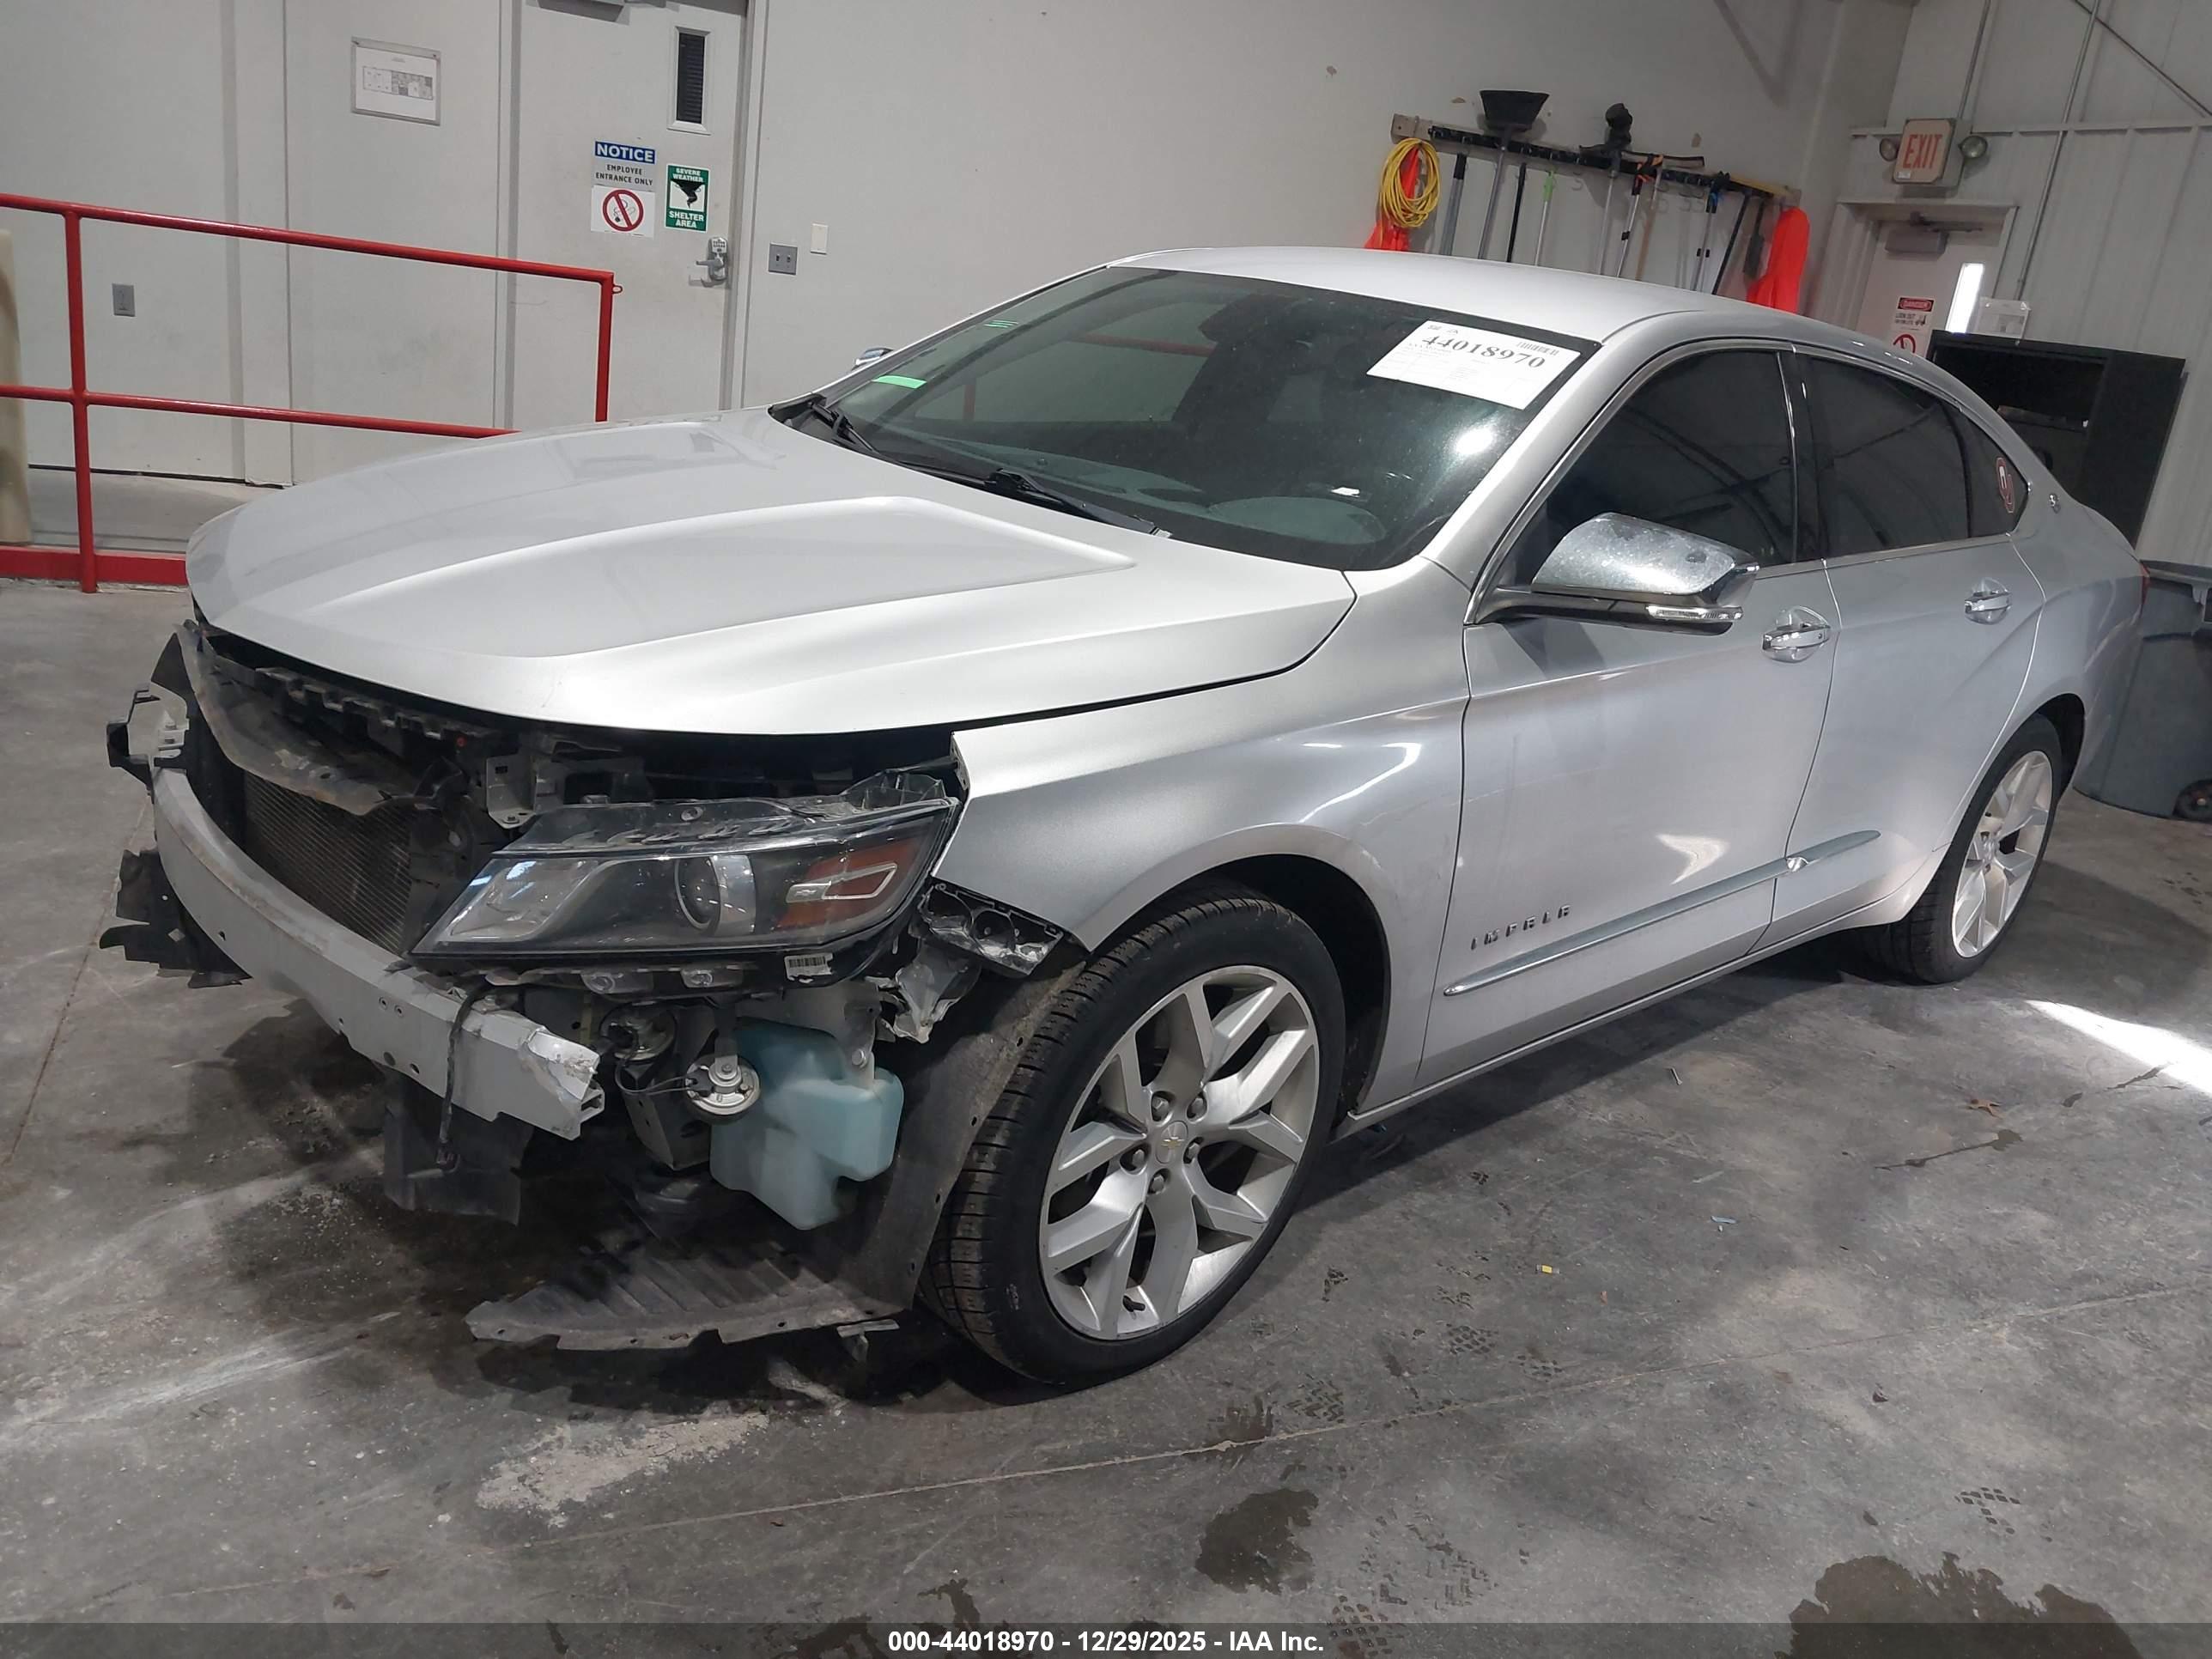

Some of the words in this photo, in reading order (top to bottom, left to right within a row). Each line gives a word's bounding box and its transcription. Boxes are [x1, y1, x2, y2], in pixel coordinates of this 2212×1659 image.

[597, 143, 653, 162] NOTICE
[1902, 134, 1942, 168] EXIT
[606, 164, 642, 176] EMPLOYEE
[676, 167, 701, 176] SEVERE
[595, 172, 632, 184] ENTRANCE
[634, 177, 653, 186] ONLY
[672, 173, 703, 183] WEATHER
[669, 210, 704, 221] SHELTER
[675, 220, 697, 228] AREA
[1422, 336, 1546, 368] 44018970
